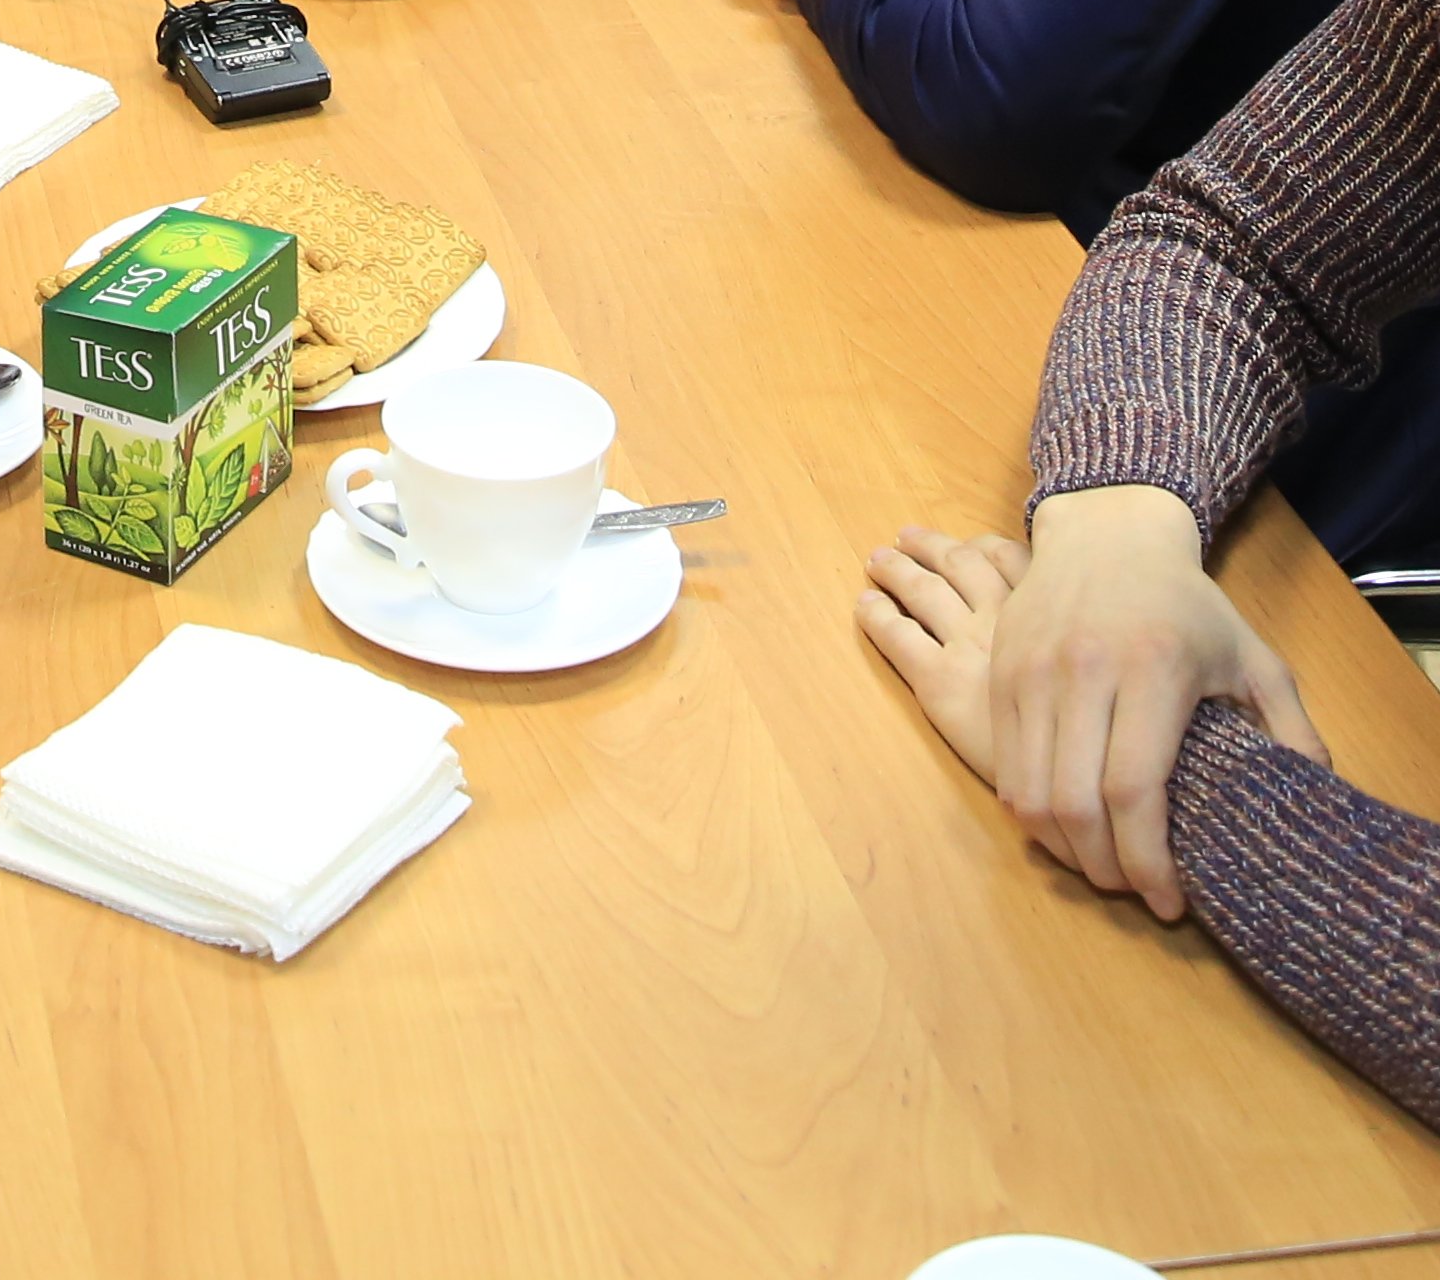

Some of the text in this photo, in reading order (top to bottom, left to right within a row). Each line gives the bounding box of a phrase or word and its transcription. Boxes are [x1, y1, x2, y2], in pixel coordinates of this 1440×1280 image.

[89, 263, 167, 306] TESS
[208, 285, 271, 376] TESS
[69, 336, 154, 391] TESS
[83, 403, 133, 426] GREEN TEA
[122, 558, 140, 570] 1,27
